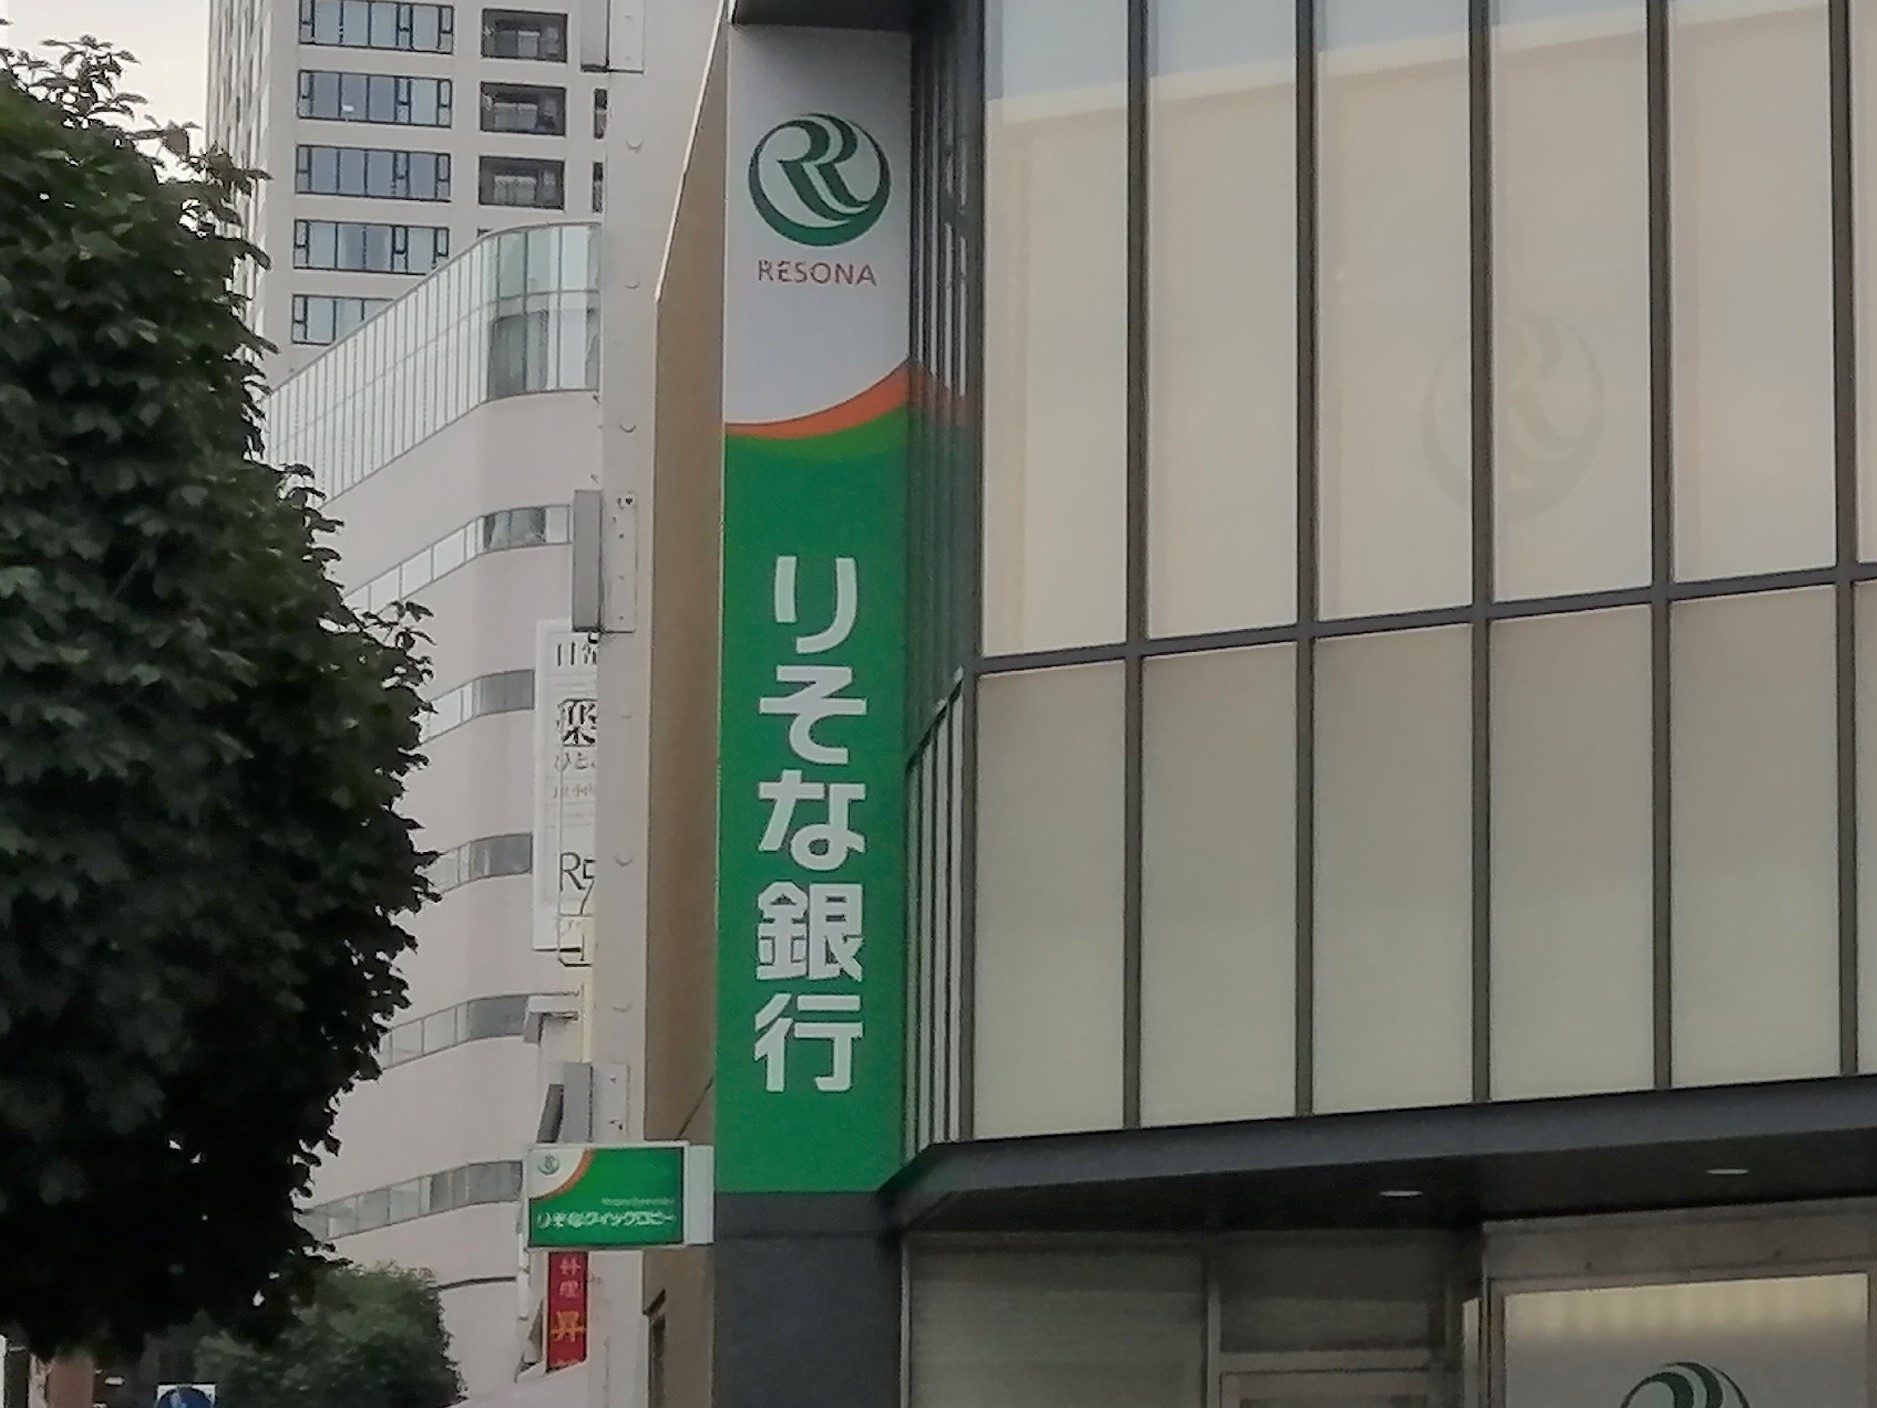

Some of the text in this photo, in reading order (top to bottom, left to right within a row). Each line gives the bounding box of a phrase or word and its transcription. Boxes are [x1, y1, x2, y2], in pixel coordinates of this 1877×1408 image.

[757, 258, 877, 289] RESONA
[753, 554, 866, 1094] りそな銀行
